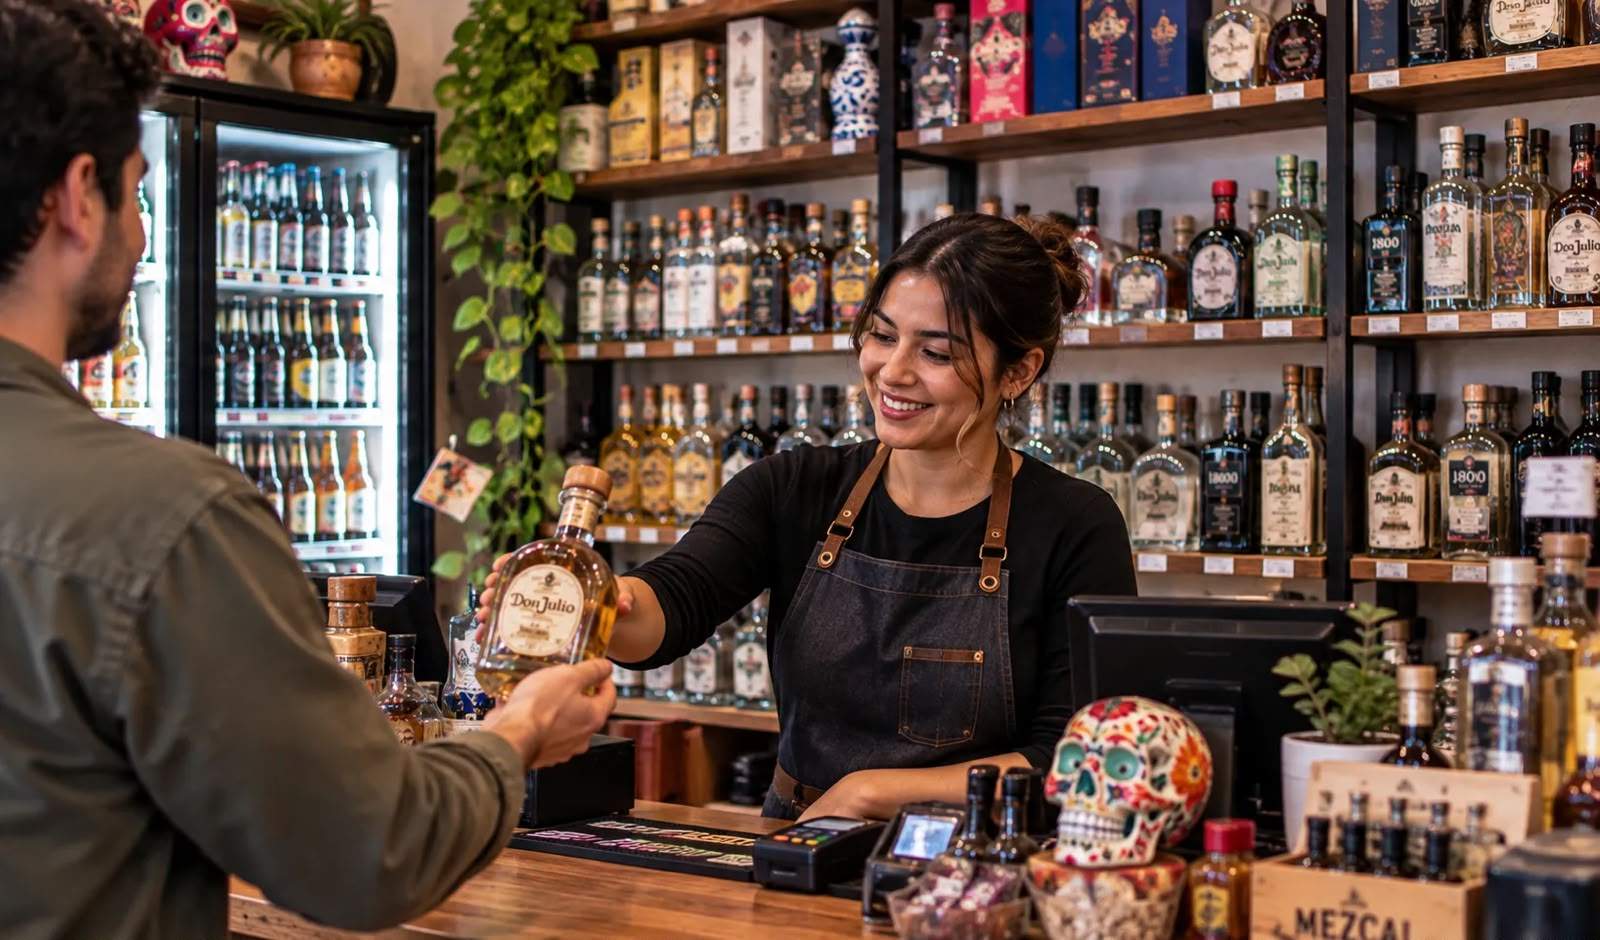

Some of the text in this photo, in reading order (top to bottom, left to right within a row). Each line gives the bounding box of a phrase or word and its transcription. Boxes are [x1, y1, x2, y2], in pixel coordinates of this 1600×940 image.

[1372, 236, 1400, 250] 1800
[510, 592, 576, 614] Don Julio
[1295, 906, 1411, 940] MEZCAL
